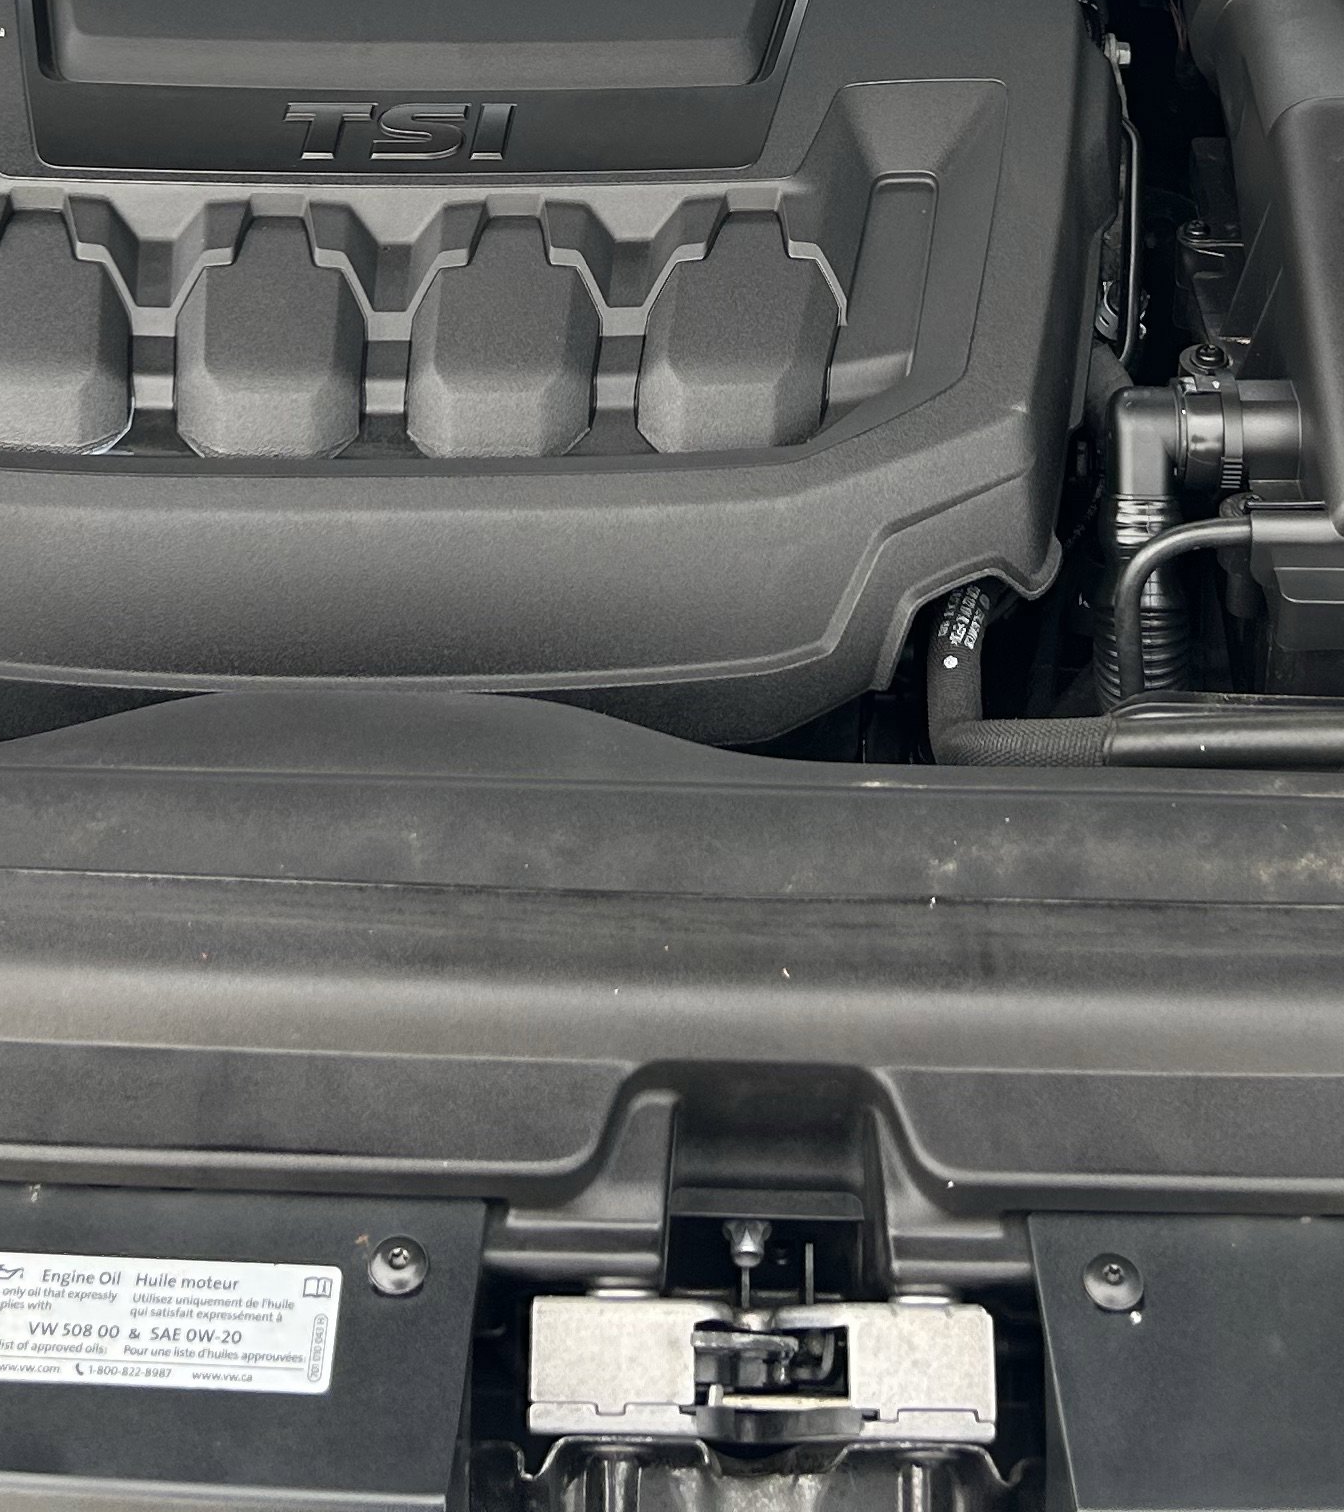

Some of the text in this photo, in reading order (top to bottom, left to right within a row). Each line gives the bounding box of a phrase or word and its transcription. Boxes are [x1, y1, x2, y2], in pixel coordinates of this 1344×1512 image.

[283, 102, 517, 161] TSI
[42, 1269, 240, 1291] Engine Oil Huile moteur
[2, 1285, 27, 1300] only
[27, 1286, 41, 1298] oil
[42, 1287, 64, 1299] that
[67, 1289, 118, 1303] expressly
[132, 1292, 173, 1305] Utilisez
[175, 1295, 243, 1311] uniquement
[245, 1297, 259, 1310] de
[23, 1299, 52, 1312] with
[130, 1306, 147, 1320] qui
[150, 1306, 193, 1319] satisfait
[196, 1308, 268, 1324] expressément
[28, 1321, 242, 1346] VW 508 00 & SAE 0W-20
[17, 1339, 29, 1352] of
[31, 1341, 83, 1355] approved
[123, 1345, 148, 1358] Pour
[150, 1347, 171, 1359] une
[173, 1346, 196, 1359] liste
[88, 1364, 173, 1379] 1-800-822-8987
[192, 1370, 253, 1384] www.vw.ca
